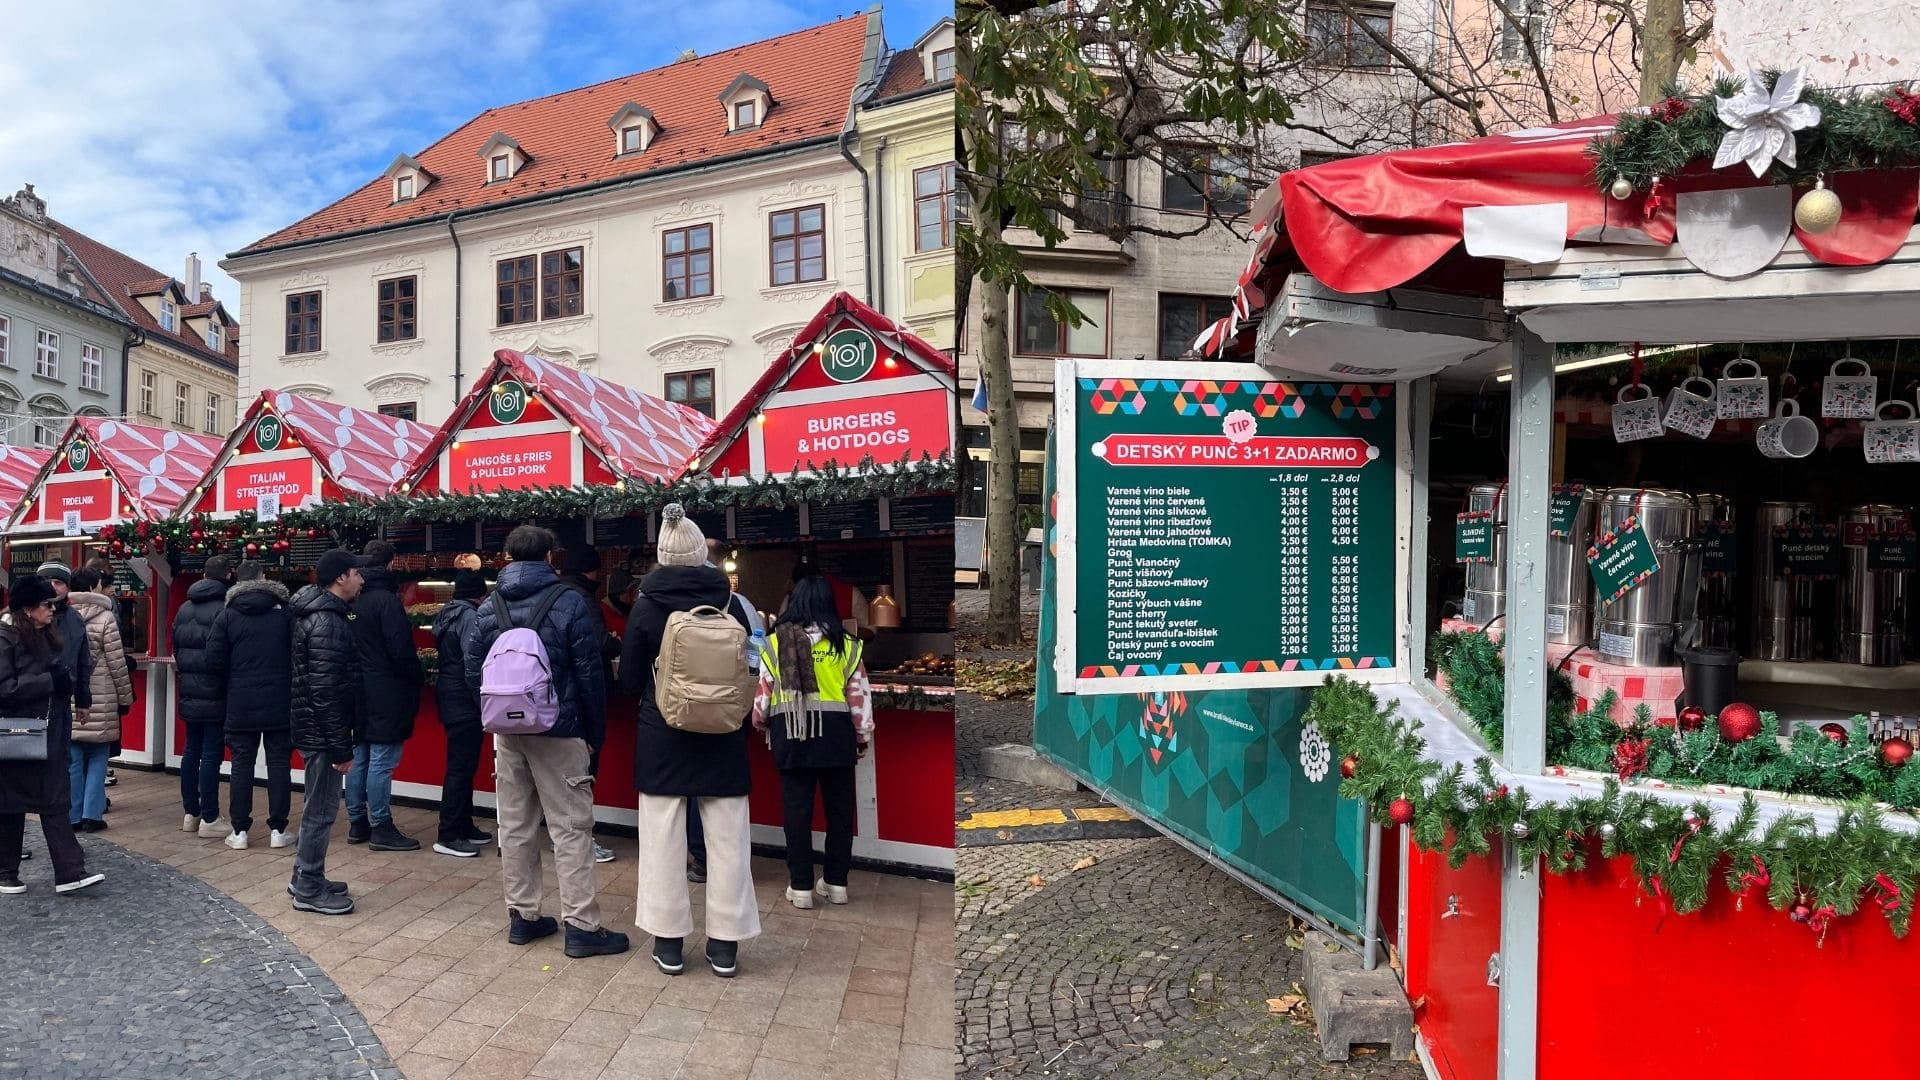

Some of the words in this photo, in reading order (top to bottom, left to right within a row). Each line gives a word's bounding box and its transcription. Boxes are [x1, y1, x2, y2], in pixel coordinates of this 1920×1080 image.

[807, 411, 896, 434] BURGERS
[1228, 418, 1251, 434] TIP
[798, 438, 810, 453] &
[813, 428, 910, 452] HOTDOGS
[1116, 441, 1186, 459] DETSKÝ
[1190, 442, 1238, 460] PUNČ
[1242, 446, 1269, 460] 3+1
[1275, 446, 1358, 461] ZADARMO
[465, 453, 512, 468] LANGOŠE
[514, 454, 521, 463] &
[522, 451, 552, 463] FRIES
[471, 469, 478, 479] &
[479, 467, 516, 479] PULLED
[517, 464, 547, 476] PORK
[249, 471, 286, 485] ITALIAN
[1293, 473, 1309, 483] dcl
[1345, 473, 1361, 483] dcl
[236, 485, 271, 499] STREET
[272, 483, 300, 496] FOOD
[1107, 486, 1141, 496] Varené
[1143, 486, 1165, 496] víno
[1167, 486, 1191, 496] biele
[1281, 487, 1300, 496] 3,50
[1301, 487, 1309, 495] €
[1332, 487, 1351, 496] 5,00
[1352, 487, 1359, 495] €
[62, 495, 94, 507] TRDELNIK
[1107, 496, 1141, 506] Varené
[1143, 496, 1165, 506] víno
[1167, 496, 1205, 506] červené
[1281, 496, 1300, 506] 3,50
[1301, 496, 1309, 505] €
[1332, 497, 1351, 506] 5,00
[1352, 497, 1359, 505] €
[1107, 506, 1141, 516] Varené
[1143, 506, 1165, 516] víno
[1167, 506, 1206, 516] slivkové
[1281, 506, 1300, 516] 4,00
[1301, 506, 1309, 515] €
[1332, 506, 1351, 516] 6,00
[1352, 506, 1359, 515] €
[1107, 517, 1141, 526] Varené
[1143, 517, 1165, 526] víno
[1281, 516, 1300, 526] 4,00
[1301, 516, 1309, 525] €
[1332, 516, 1351, 526] 6,00
[1352, 516, 1359, 525] €
[1107, 527, 1141, 536] Varené
[1143, 527, 1165, 536] víno
[1167, 526, 1211, 538] jahodové
[1281, 526, 1300, 536] 4,00
[1301, 526, 1309, 535] €
[1332, 526, 1351, 536] 6,00
[1352, 526, 1359, 535] €
[1139, 536, 1186, 546] Medovina
[1188, 536, 1231, 547] (TOMKA)
[1281, 536, 1300, 546] 3,50
[1301, 536, 1309, 545] €
[1332, 536, 1351, 545] 4,50
[1352, 536, 1359, 544] €
[1107, 547, 1133, 558] Grog
[1281, 546, 1300, 556] 4,00
[1301, 546, 1309, 555] €
[1598, 549, 1621, 571] Varené
[1620, 540, 1637, 554] víno
[1107, 558, 1134, 568] Punč
[1135, 557, 1180, 568] Vianočný
[1281, 555, 1300, 566] 4,00
[1301, 555, 1309, 565] €
[1332, 555, 1351, 565] 5,50
[1352, 555, 1359, 564] €
[1607, 551, 1635, 577] červené
[1107, 568, 1134, 578] Punč
[1135, 567, 1173, 578] višňový
[1281, 565, 1300, 576] 5,00
[1301, 565, 1309, 575] €
[1332, 565, 1351, 575] 6,50
[1352, 565, 1359, 574] €
[1107, 578, 1134, 588] Punč
[1281, 575, 1300, 586] 5,00
[1301, 575, 1309, 585] €
[1332, 575, 1351, 585] 6,50
[1352, 575, 1359, 584] €
[1107, 588, 1147, 600] Kozičky
[1281, 585, 1300, 595] 5,00
[1301, 585, 1309, 594] €
[1332, 585, 1351, 594] 6,50
[1352, 585, 1359, 593] €
[1108, 599, 1134, 609] Punč
[1135, 598, 1172, 610] výbuch
[1173, 598, 1203, 608] vášne
[1281, 595, 1300, 605] 5,00
[1301, 595, 1309, 604] €
[1332, 594, 1351, 604] 6,50
[1352, 594, 1359, 603] €
[1281, 605, 1300, 615] 5,00
[1301, 605, 1309, 614] €
[1332, 604, 1351, 614] 6,50
[1352, 604, 1359, 613] €
[1108, 610, 1134, 619] Punč
[1135, 609, 1167, 620] cherry
[1332, 614, 1351, 624] 6,50
[1352, 614, 1359, 623] €
[1108, 620, 1134, 629] Punč
[1135, 619, 1166, 630] tekutý
[1167, 618, 1199, 628] sveter
[1281, 615, 1300, 625] 5,00
[1301, 615, 1309, 624] €
[1281, 624, 1300, 635] 5,00
[1301, 624, 1309, 634] €
[1332, 624, 1351, 634] 6,50
[1352, 624, 1359, 633] €
[1108, 630, 1134, 640] Punč
[1281, 635, 1300, 645] 3,00
[1301, 635, 1309, 644] €
[1332, 634, 1351, 643] 3,50
[1352, 634, 1359, 642] €
[1108, 640, 1141, 651] Detský
[1144, 639, 1169, 650] punč
[1170, 640, 1177, 649] s
[1179, 638, 1215, 648] ovocím
[1332, 643, 1351, 653] 3,00
[1352, 643, 1359, 652] €
[1281, 645, 1300, 655] 2,50
[1301, 645, 1309, 654] €
[1108, 649, 1125, 662] Čaj
[1126, 650, 1163, 661] ovocný
